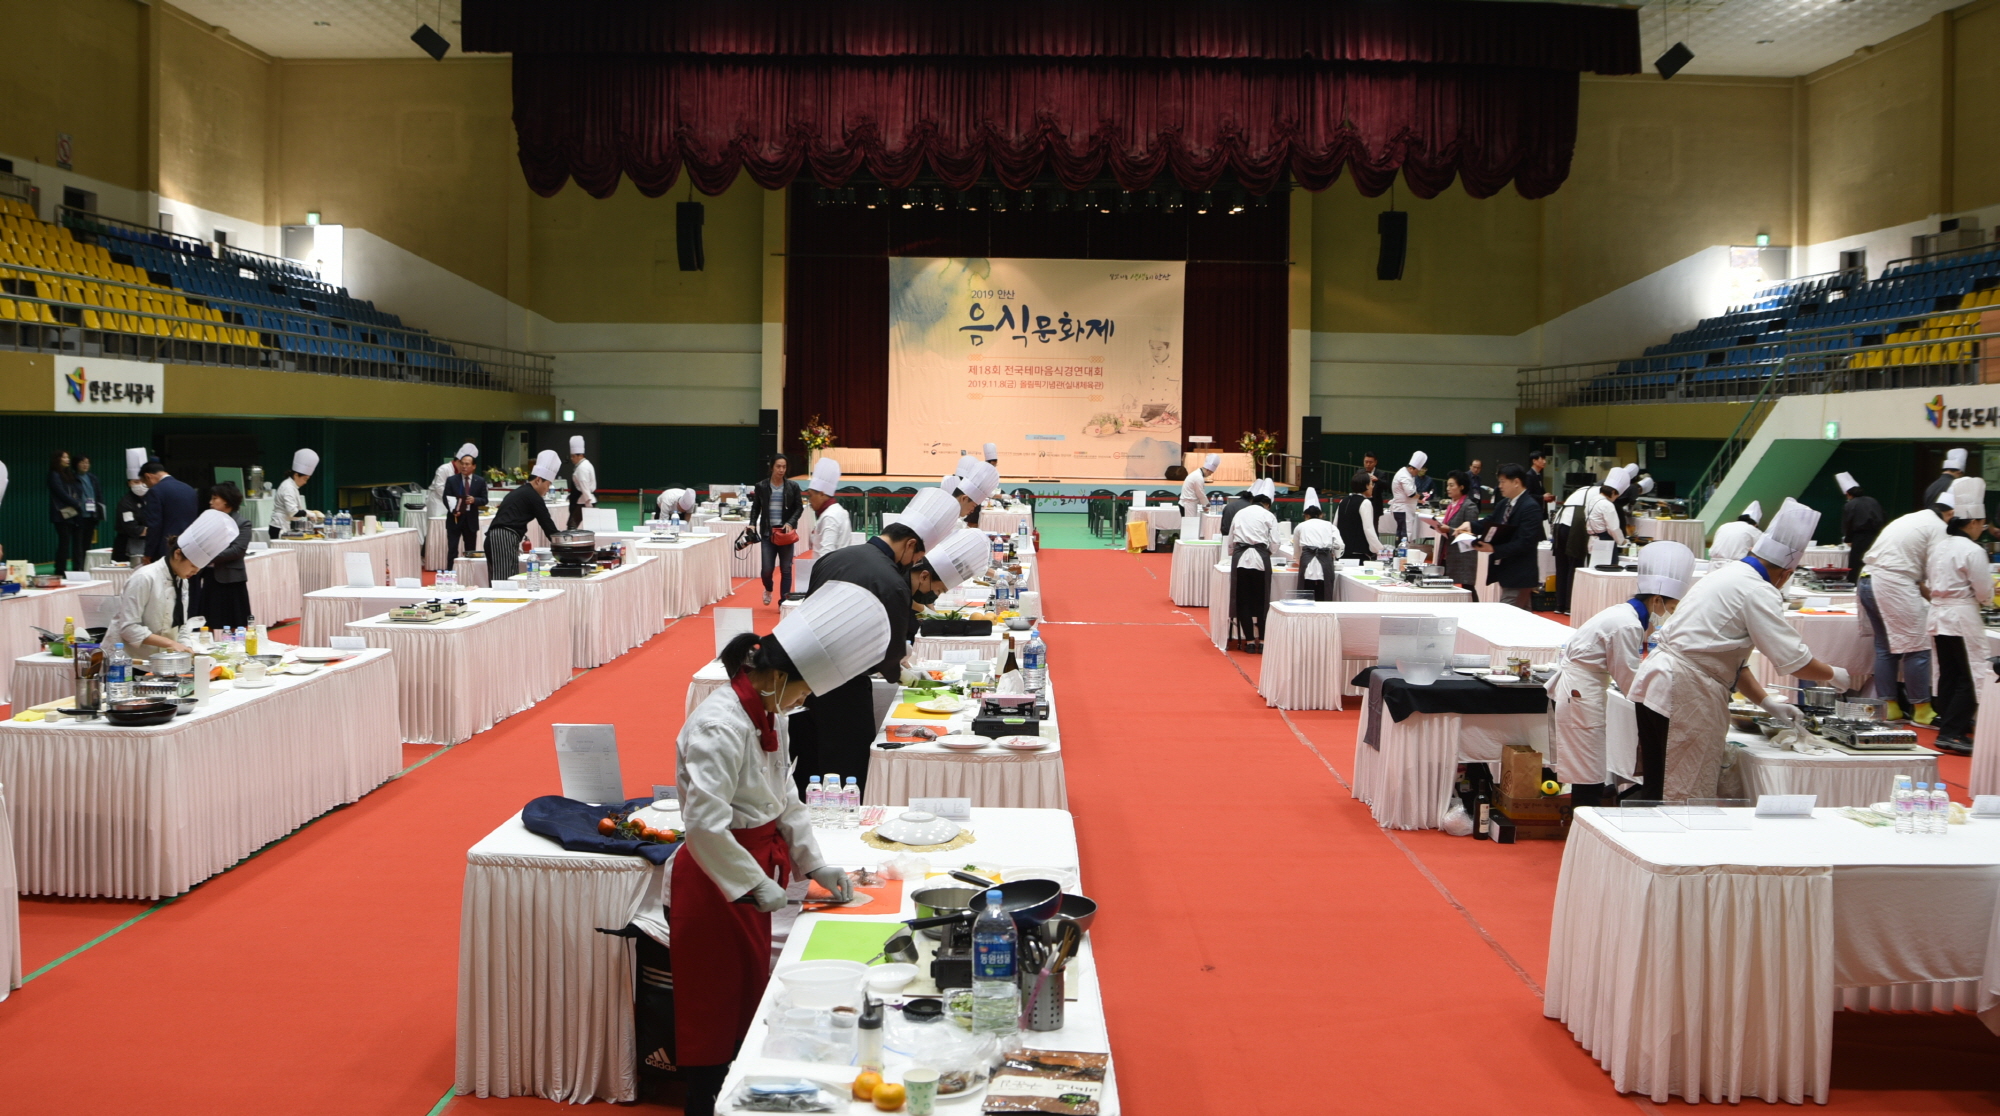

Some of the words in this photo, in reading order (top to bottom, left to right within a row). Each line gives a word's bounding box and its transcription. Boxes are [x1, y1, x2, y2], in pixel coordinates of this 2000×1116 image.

[1155, 273, 1171, 281] 안산
[971, 290, 994, 299] 2019
[997, 289, 1015, 300] 안산
[959, 302, 1115, 348] 음식문화제
[968, 365, 1001, 375] 제18회
[1004, 365, 1103, 377] 전국테마음식경연대회
[967, 380, 1017, 390] 2019.11.8(금)
[1019, 380, 1104, 390] 올림픽기념관(실내체육관)
[89, 381, 155, 404] 안산도시공사
[1948, 406, 2000, 429] 안산도시
[980, 954, 1011, 964] 동원샘물
[645, 1057, 677, 1072] adidas
